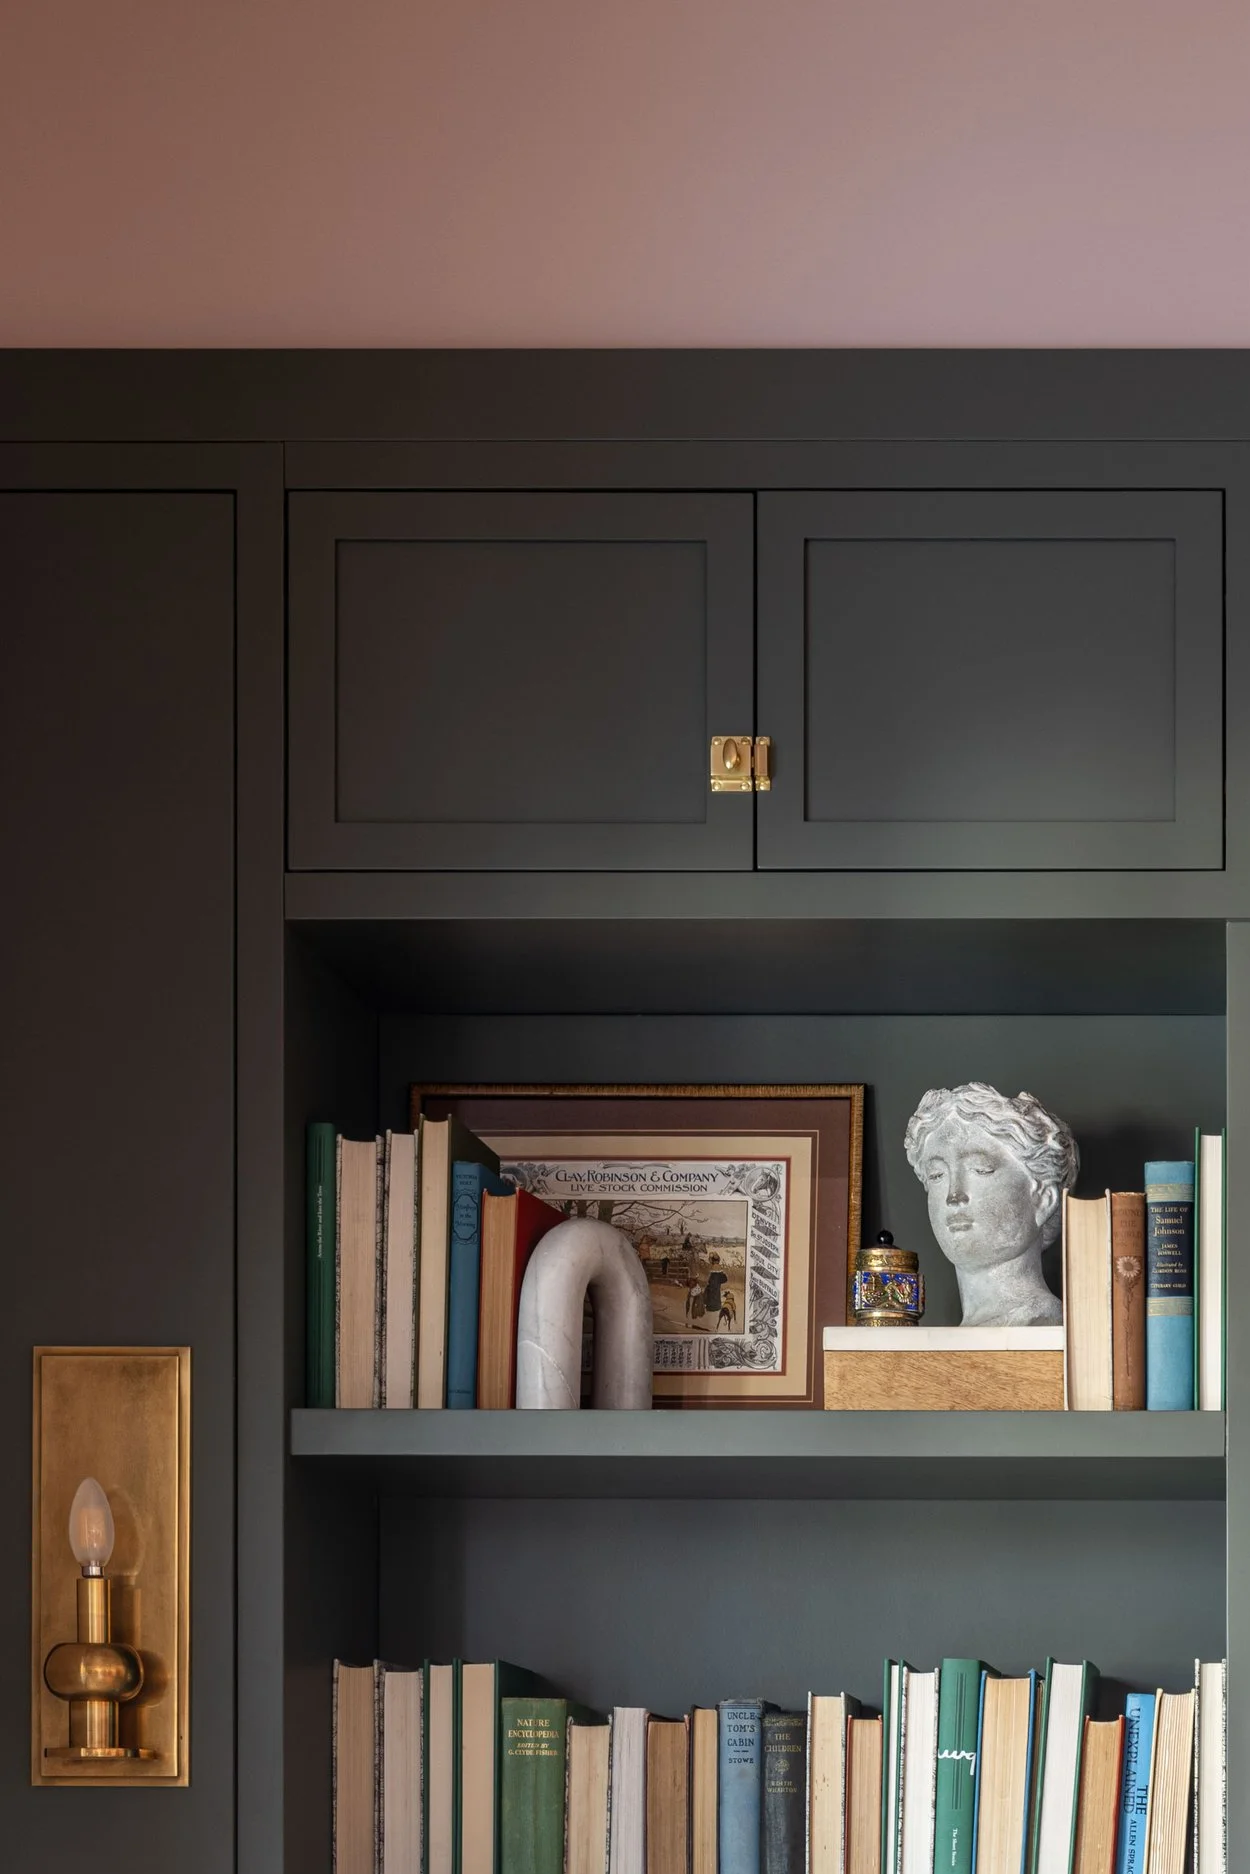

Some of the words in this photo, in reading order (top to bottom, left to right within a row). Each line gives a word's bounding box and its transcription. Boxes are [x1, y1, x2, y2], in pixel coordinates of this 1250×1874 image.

[555, 1170, 586, 1183] CLAY,
[587, 1170, 647, 1184] ROBINSON
[650, 1171, 660, 1182] &
[663, 1170, 719, 1183] COMPANY
[570, 1184, 597, 1192] LIVE
[599, 1184, 635, 1192] STOCK
[640, 1184, 708, 1192] COMMISSION
[1155, 1216, 1183, 1224] Samuel
[1154, 1226, 1185, 1237] Johnson
[727, 1711, 756, 1720] UNCLE
[517, 1718, 550, 1727] NATURE
[727, 1724, 755, 1733] TOM'S
[508, 1730, 559, 1738] ENCYCLOPEDIA
[727, 1738, 755, 1746] CABIN
[1123, 1708, 1141, 1814] UNEXPLAINED
[1135, 1784, 1148, 1815] THE
[1129, 1819, 1137, 1846] ALLEN
